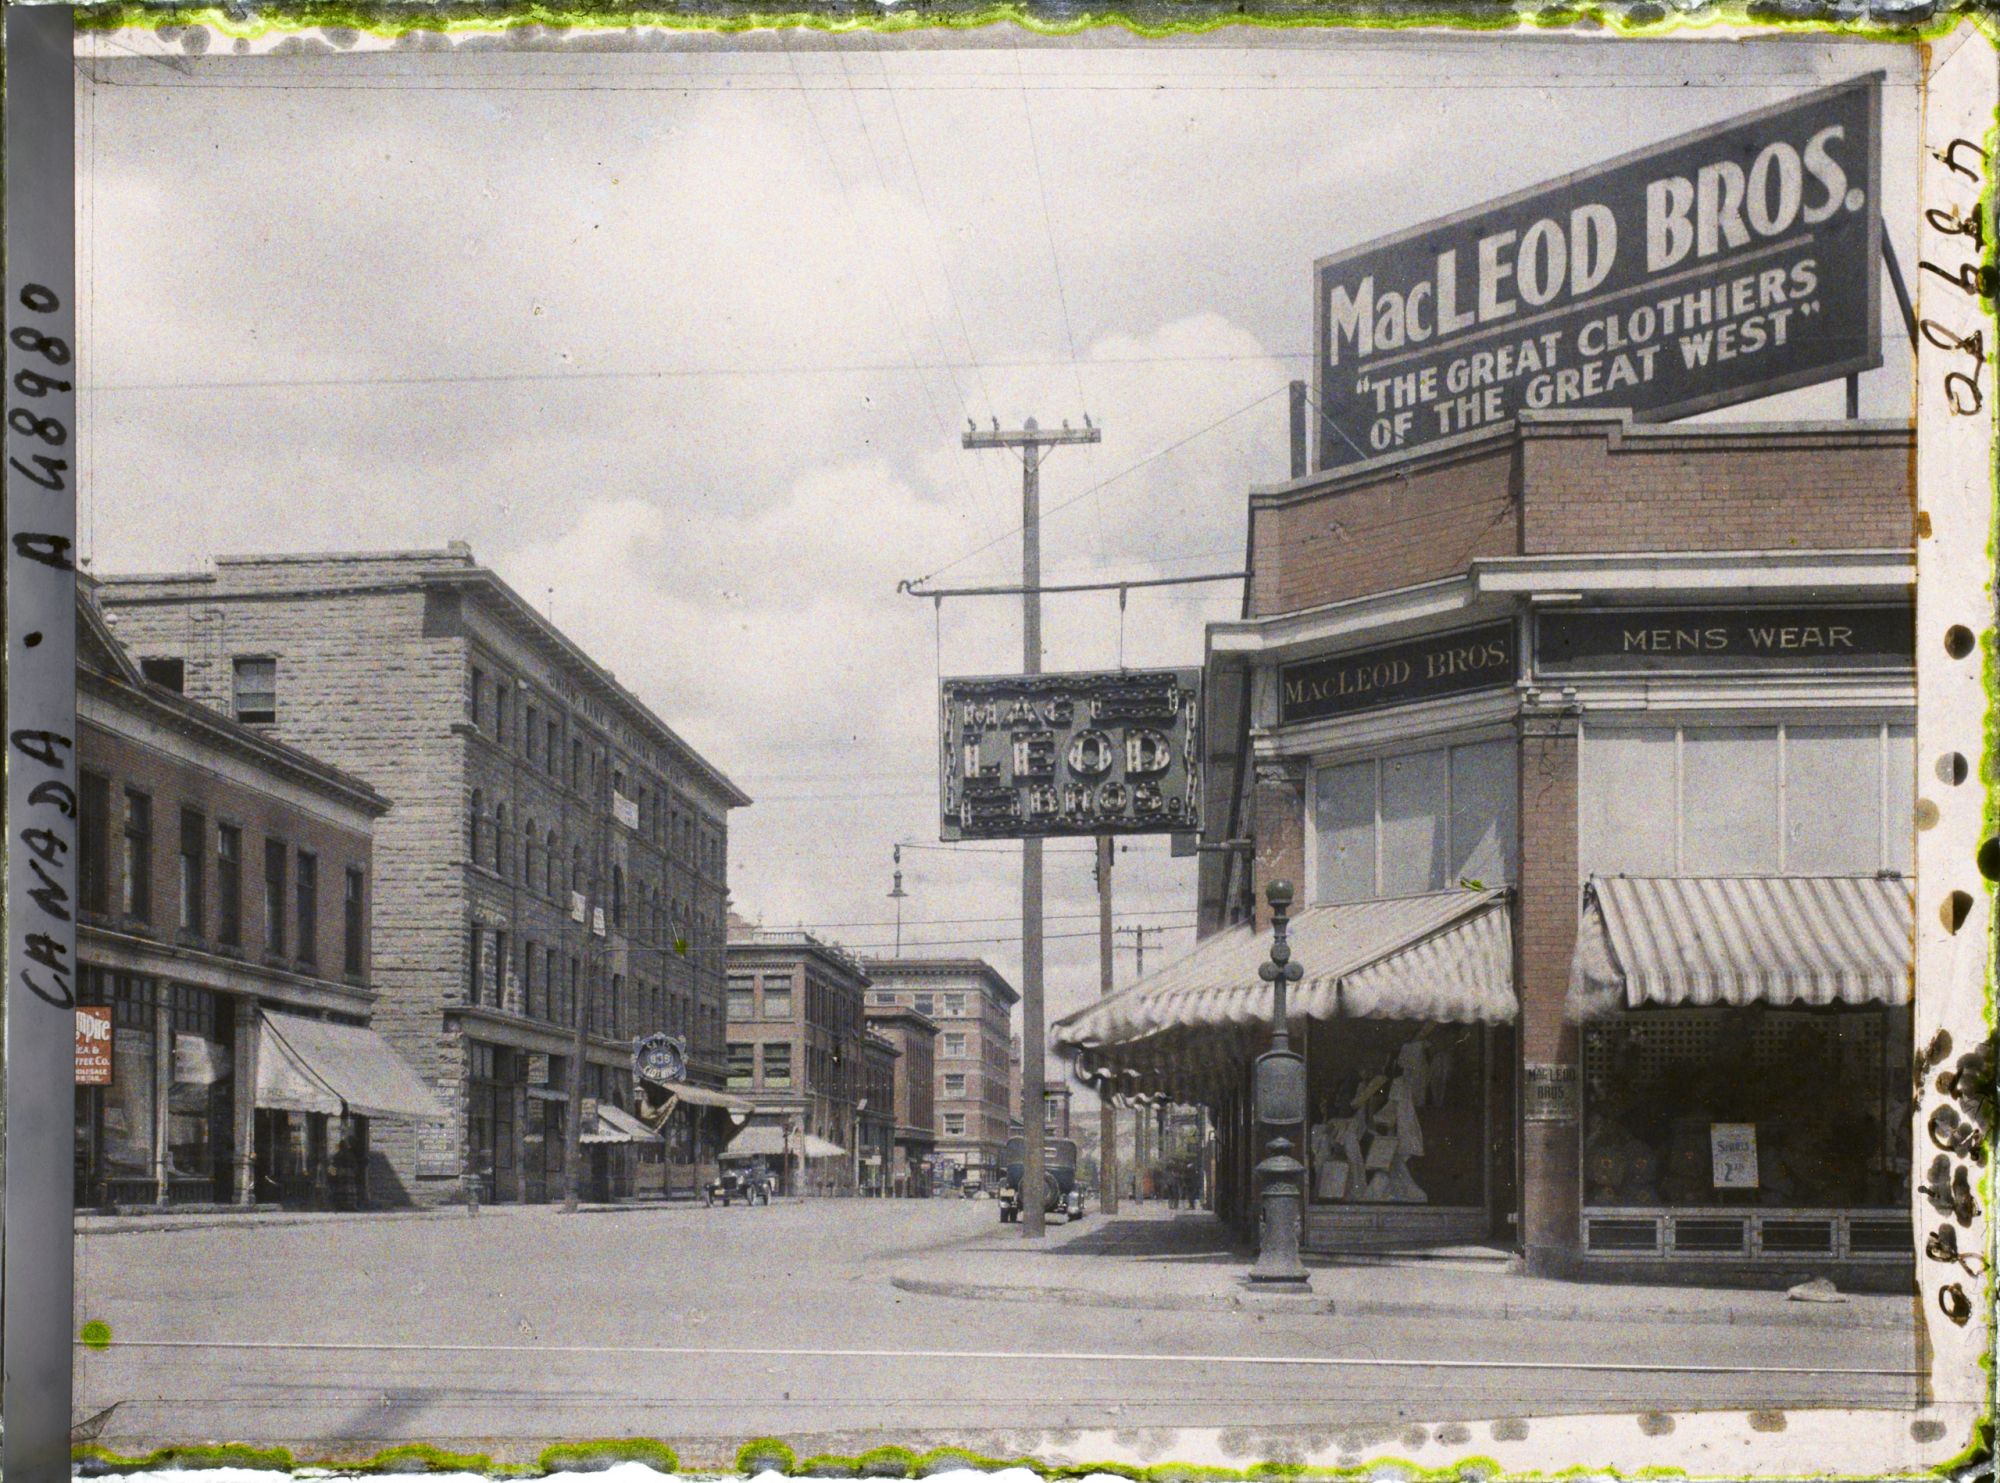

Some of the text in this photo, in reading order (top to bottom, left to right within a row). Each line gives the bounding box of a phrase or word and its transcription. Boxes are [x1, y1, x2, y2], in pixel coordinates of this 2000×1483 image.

[1330, 126, 1866, 367] MacLEOD BROS.
[1446, 331, 1562, 396] GREAT
[1577, 259, 1819, 357] CLOTHIERS
[1370, 415, 1412, 451] OF
[1434, 386, 1506, 437] THE
[1525, 346, 1662, 409] GREAT
[8, 282, 75, 1009] CANADA A 48980
[1426, 639, 1510, 679] BROS.
[1623, 626, 1854, 650] MENS WEAR
[963, 728, 1171, 784] LEOD
[1029, 781, 1180, 815] BROS.
[75, 1011, 111, 1043] mpire
